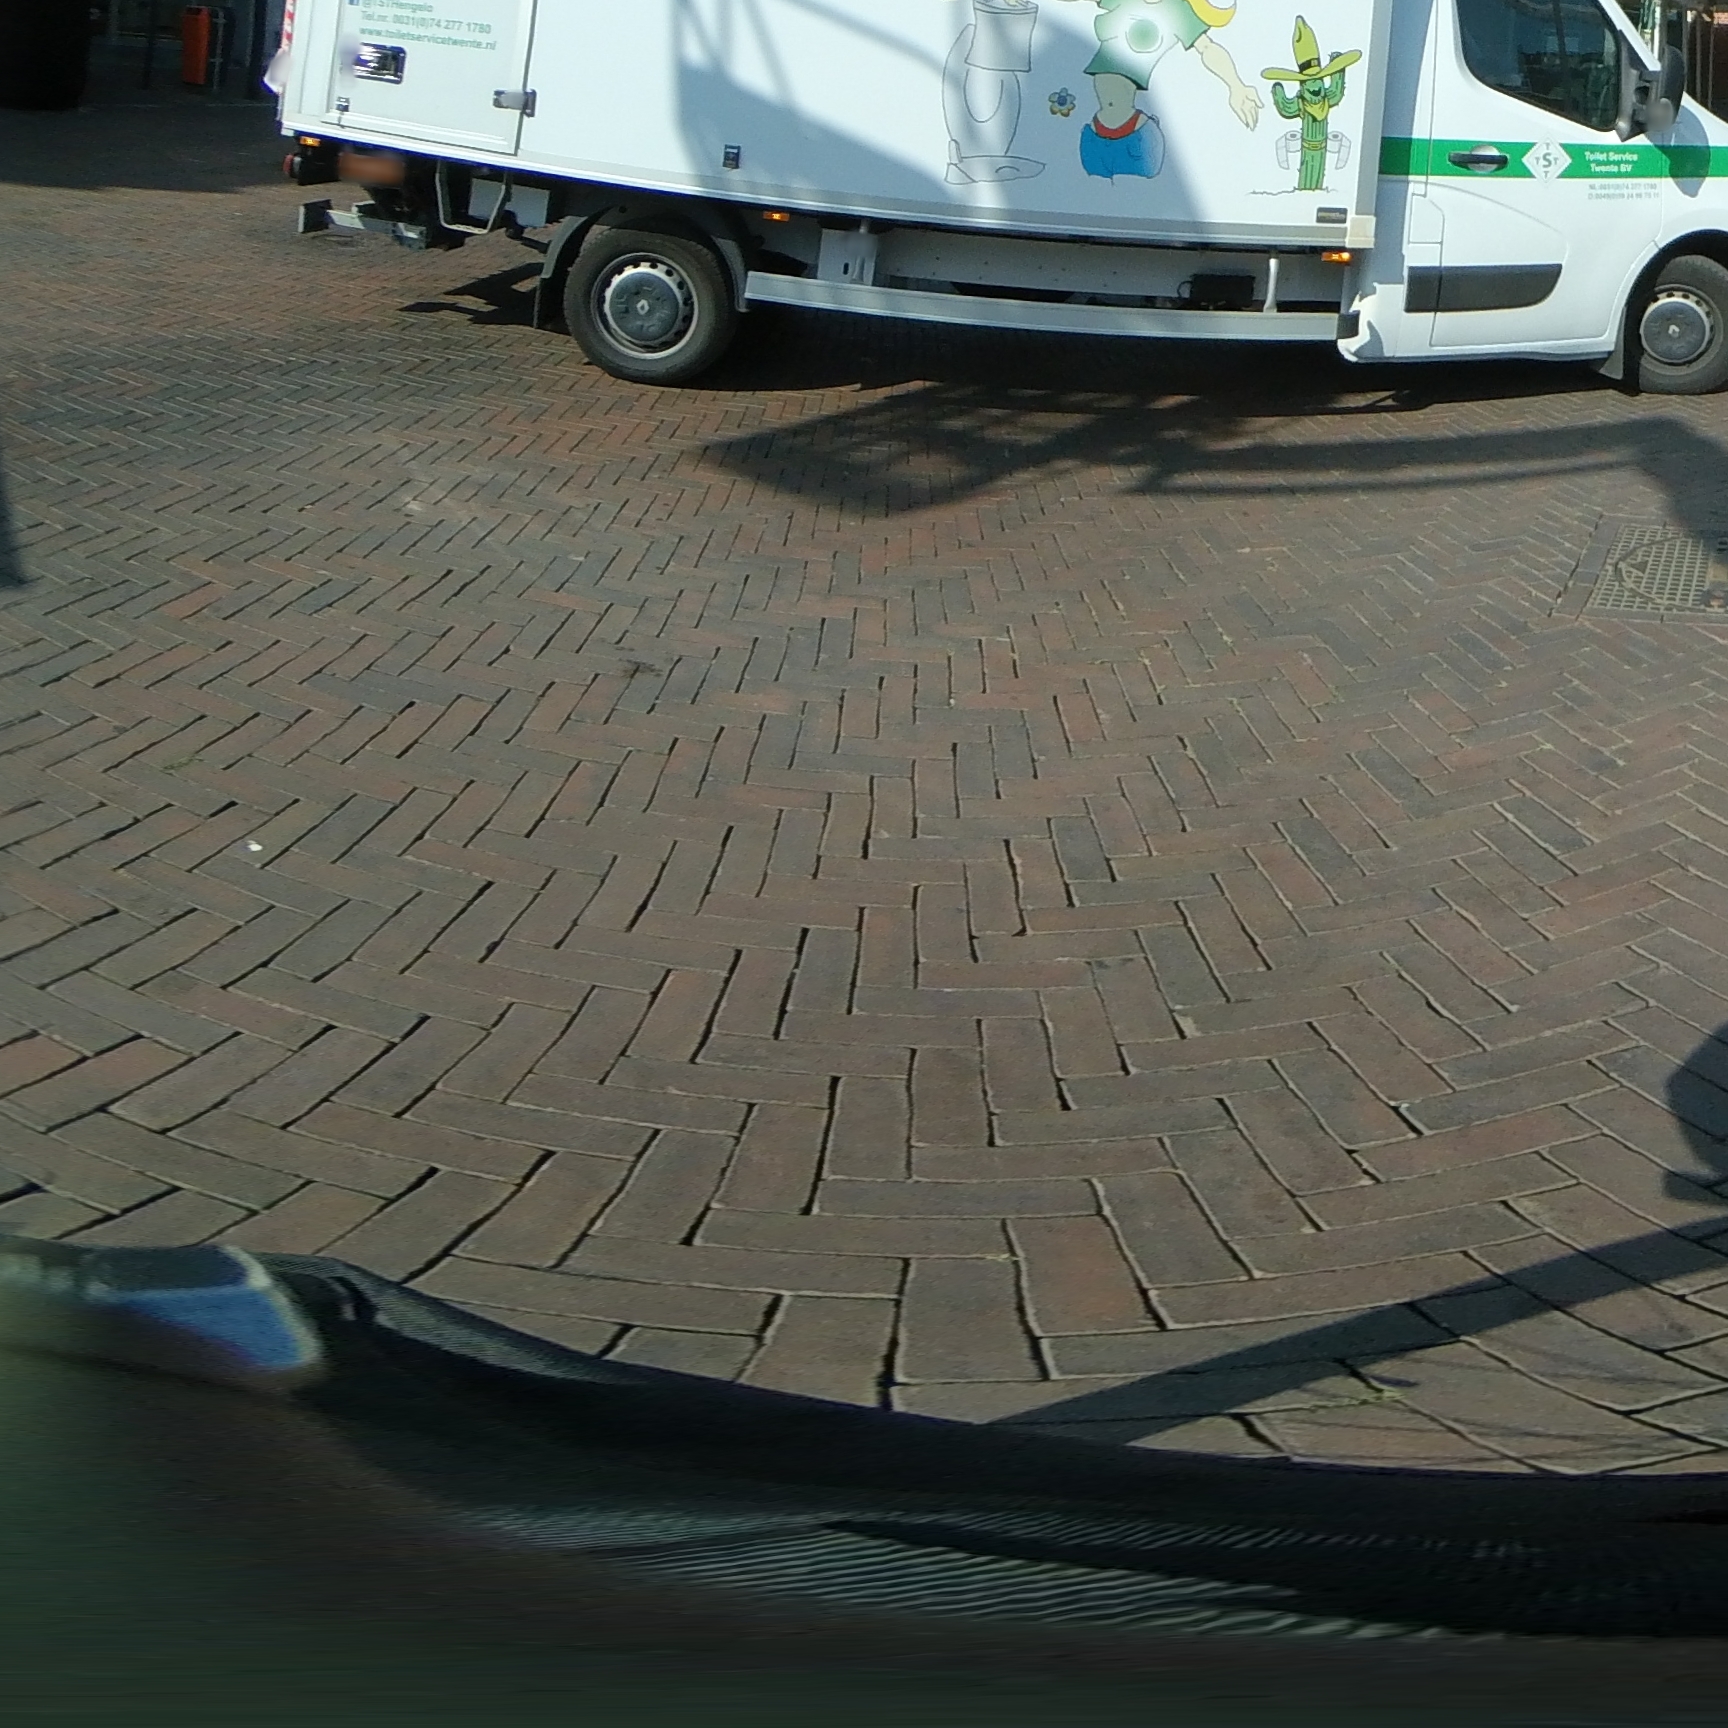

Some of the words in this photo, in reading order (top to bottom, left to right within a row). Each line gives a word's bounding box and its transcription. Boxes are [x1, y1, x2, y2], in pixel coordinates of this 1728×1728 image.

[443, 18, 464, 31] 277
[1584, 151, 1607, 161] Toilet
[1608, 151, 1639, 161] Service
[1590, 163, 1619, 173] Twente
